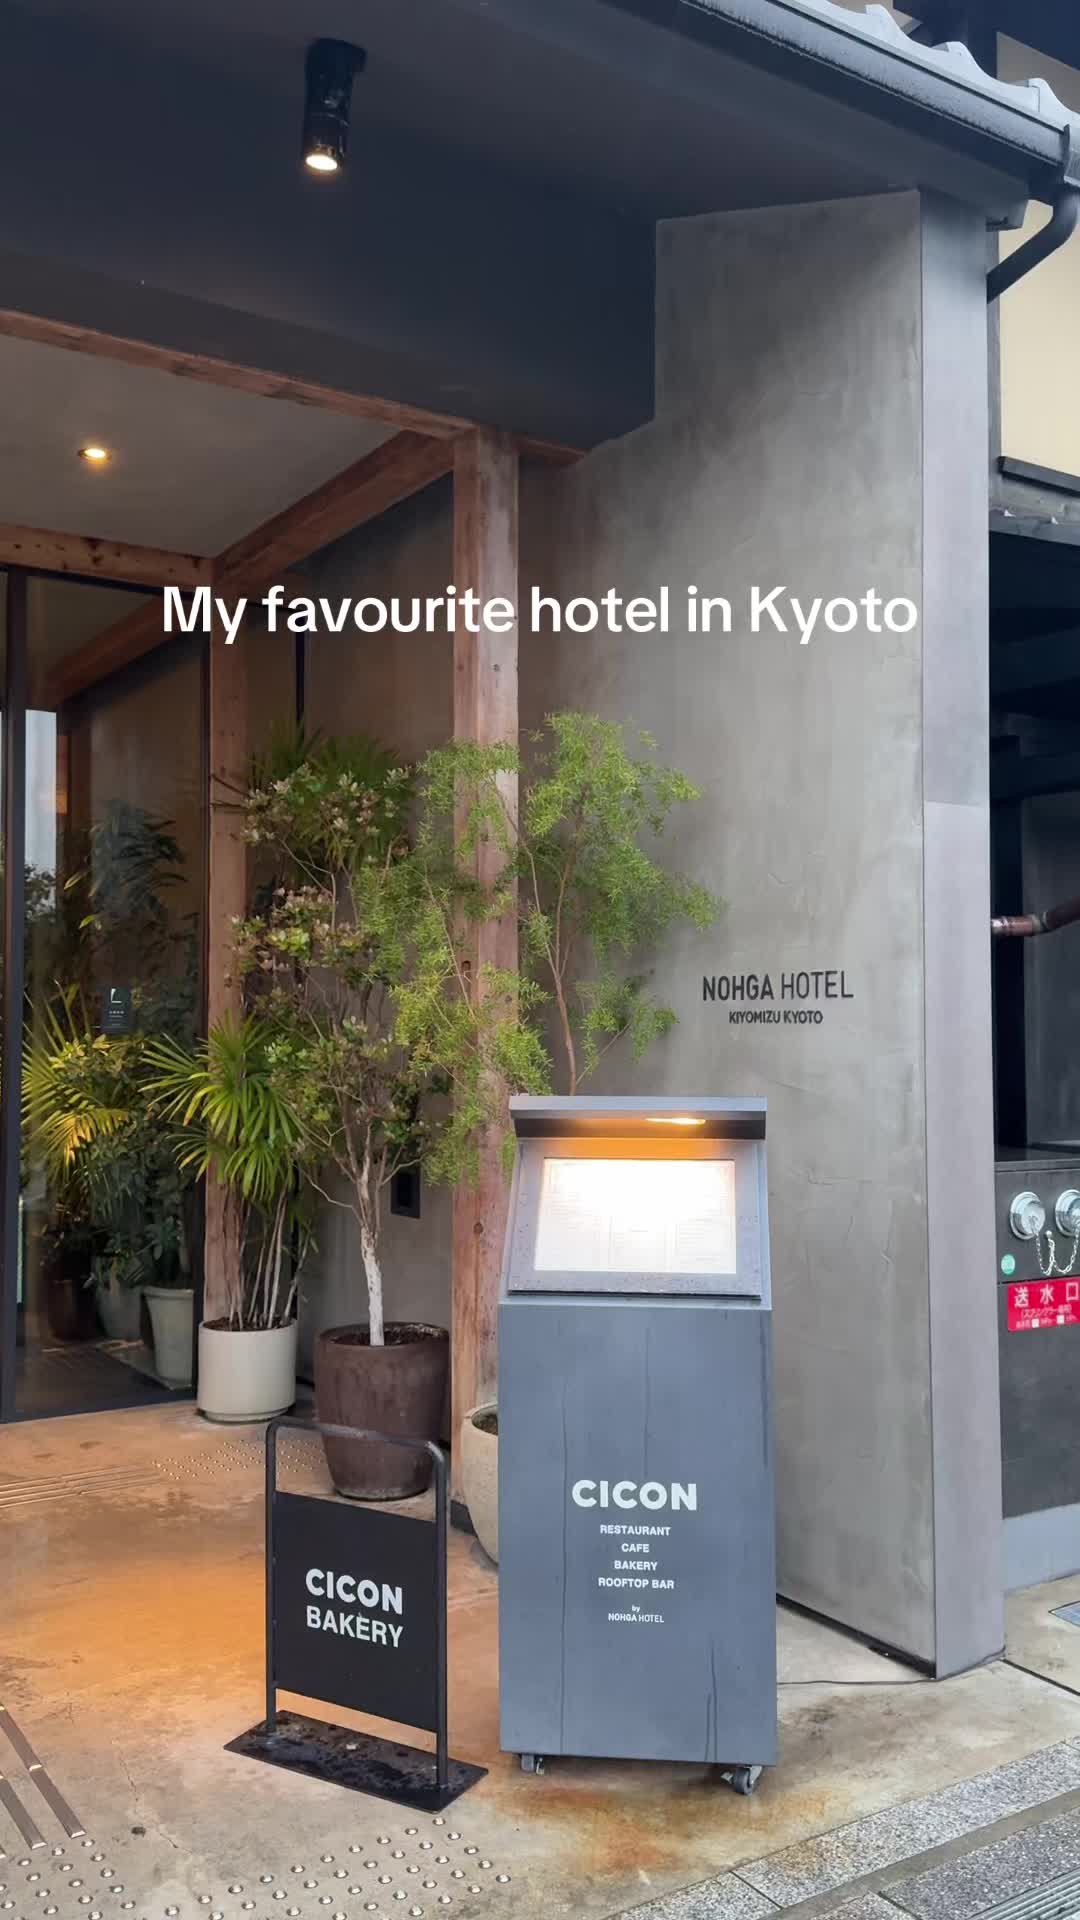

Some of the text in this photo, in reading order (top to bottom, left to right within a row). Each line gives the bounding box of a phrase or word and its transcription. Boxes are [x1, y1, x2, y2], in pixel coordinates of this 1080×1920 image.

[702, 970, 854, 1001] NOHGA HOTEL
[728, 1010, 824, 1024] KIYOMIZU KYOTO
[572, 1479, 698, 1511] CICON
[600, 1524, 672, 1536] RESTAURANT
[621, 1543, 650, 1553] CAFE
[614, 1560, 658, 1571] BAKERY
[598, 1577, 675, 1589] ROOFTOP BAR
[305, 1568, 403, 1615] CICON
[631, 1605, 641, 1613] by
[608, 1613, 665, 1623] NOHGA HOTEL
[306, 1604, 404, 1648] BAKERY
